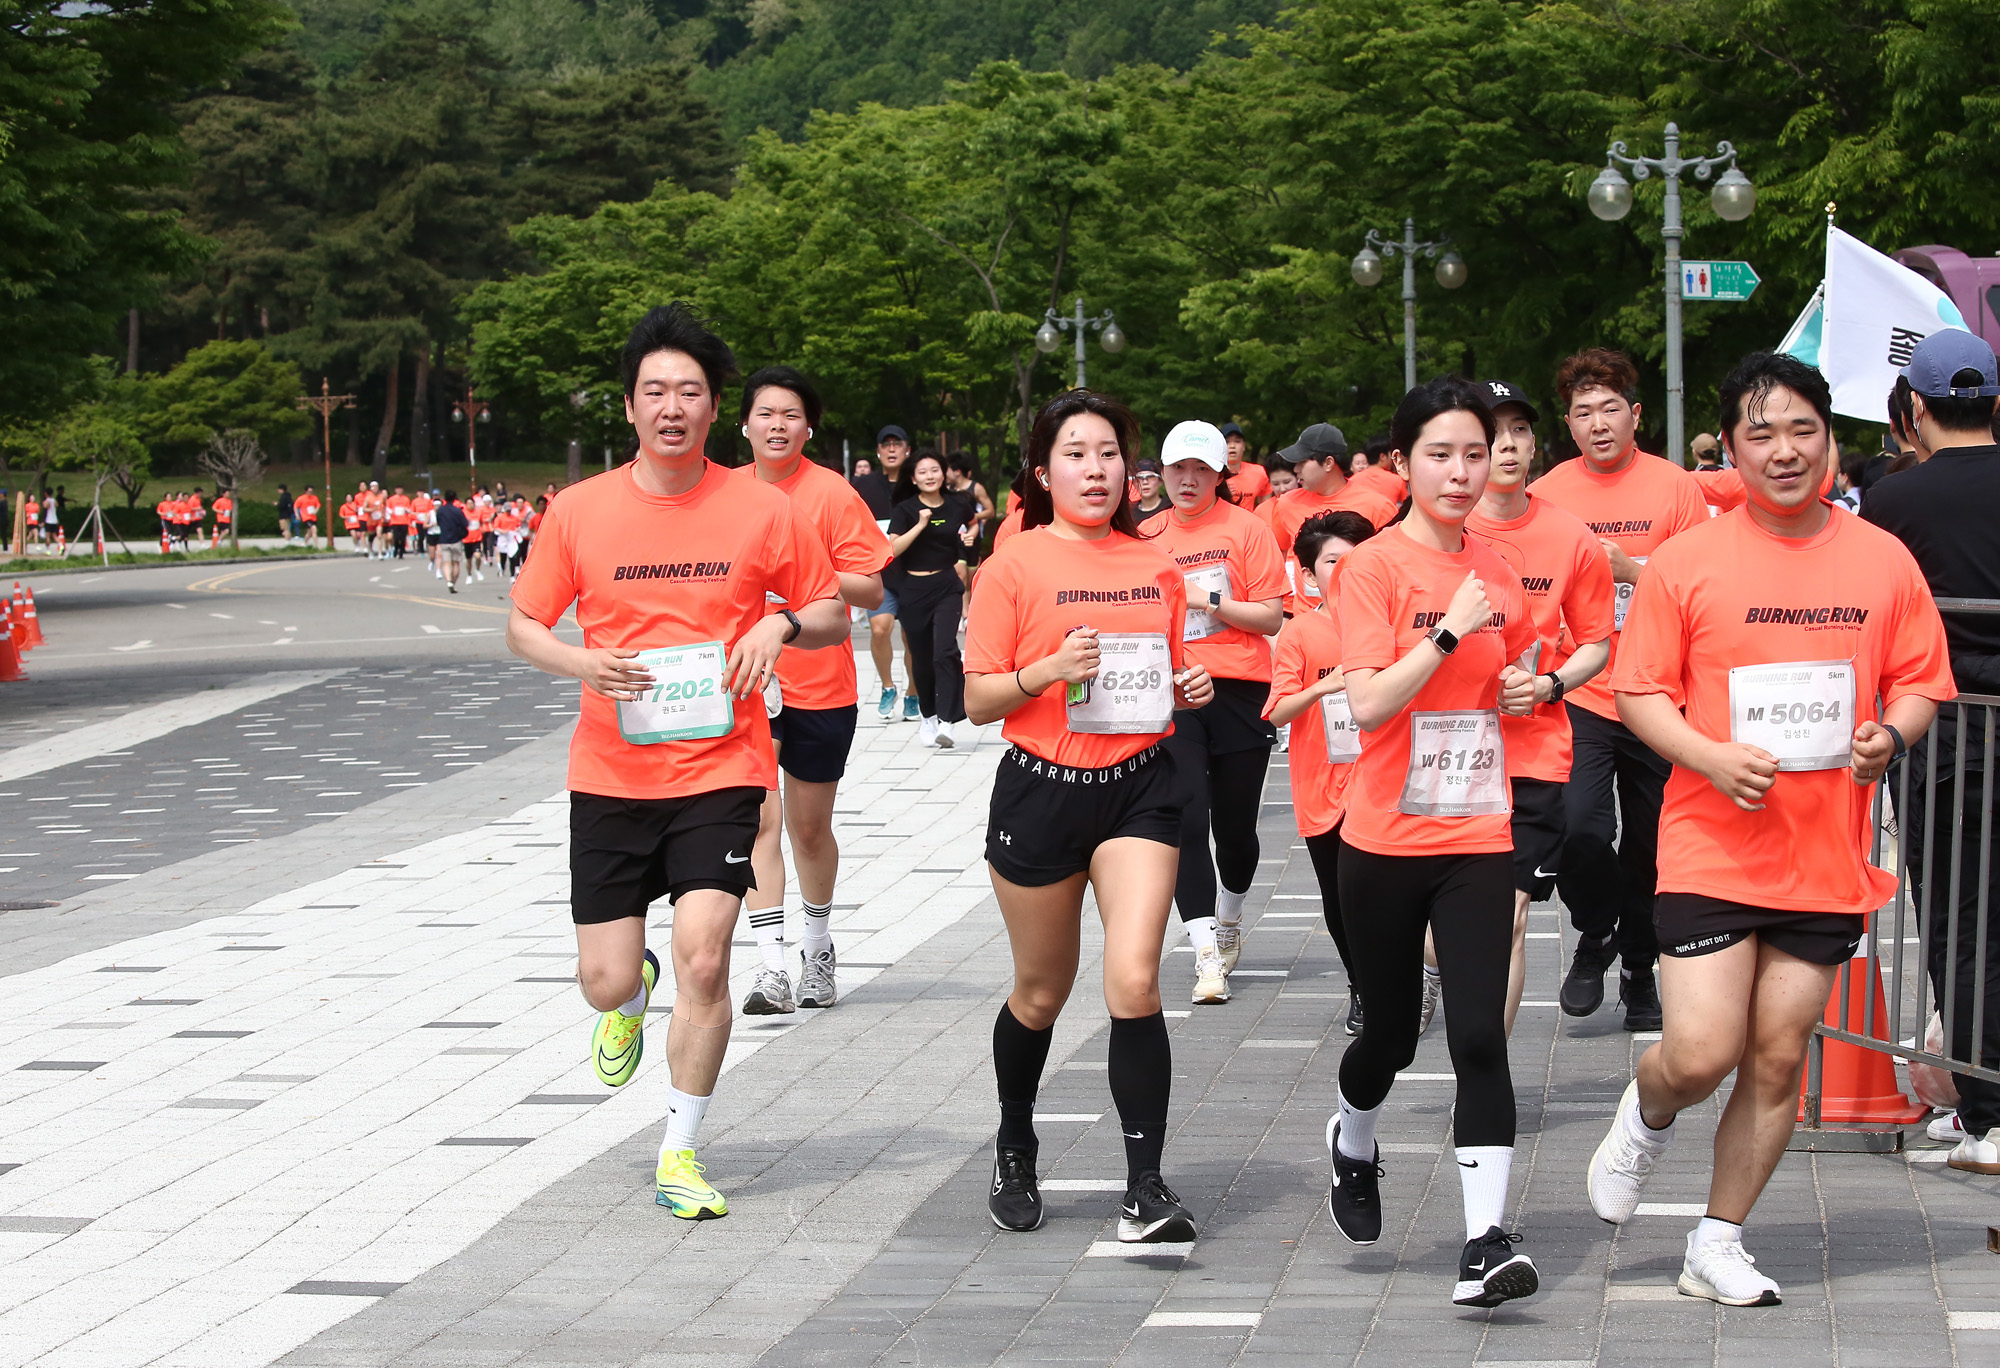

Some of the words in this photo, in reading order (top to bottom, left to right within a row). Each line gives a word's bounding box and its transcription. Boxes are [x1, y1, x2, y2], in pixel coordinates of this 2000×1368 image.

[1489, 382, 1511, 397] LA
[1586, 522, 1622, 533] NING
[1623, 521, 1652, 532] RUN
[1203, 549, 1230, 560] RUN
[614, 563, 692, 581] BURNING
[693, 562, 731, 577] RUN
[1522, 577, 1553, 591] RUN
[1056, 590, 1129, 605] BURNING
[1131, 586, 1160, 600] RUN
[1745, 607, 1830, 624] BURNING
[1829, 606, 1869, 624] RUN
[1121, 642, 1139, 651] RUN
[664, 655, 683, 664] RUN
[1102, 670, 1162, 691] 6239
[1743, 673, 1789, 684] BURNING
[1790, 672, 1813, 681] RUN
[1828, 672, 1845, 680] 5km
[652, 677, 715, 703] 7202
[1114, 695, 1138, 704] 장주미
[1747, 708, 1764, 721] M
[1769, 701, 1841, 725] 5064
[1334, 721, 1345, 730] M
[1421, 720, 1457, 730] BURNING
[1457, 719, 1478, 729] RUN
[1486, 720, 1496, 728] 5km
[1784, 729, 1811, 739] 김성진
[1422, 754, 1437, 768] W
[1438, 748, 1495, 770] 6123
[1032, 760, 1122, 784] ARMOUR
[1446, 776, 1472, 785] 정진주
[1675, 941, 1697, 954] NIKE
[1697, 937, 1713, 948] JUST
[1714, 935, 1724, 944] DO
[1724, 933, 1730, 942] IT
